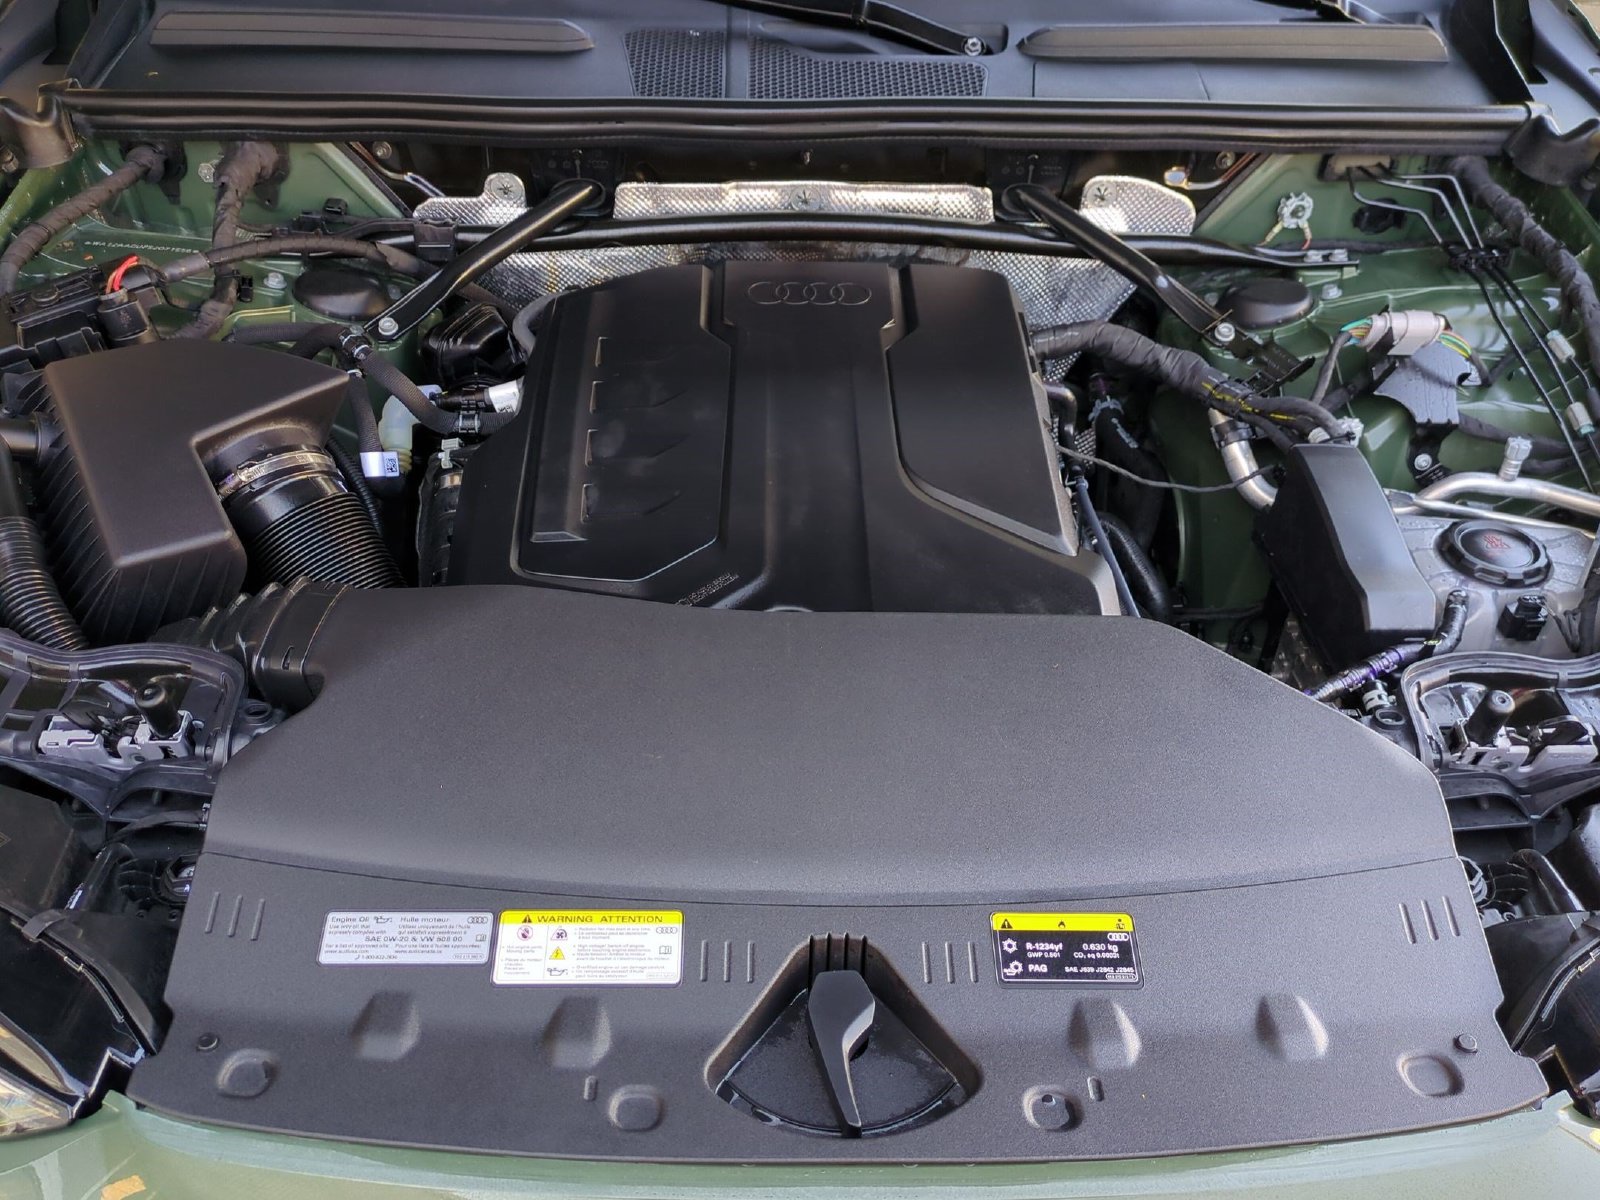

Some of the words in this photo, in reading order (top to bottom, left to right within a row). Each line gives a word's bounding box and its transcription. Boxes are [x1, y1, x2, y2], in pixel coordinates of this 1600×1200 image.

[537, 915, 593, 923] WARNING
[600, 915, 663, 923] ATTENTION
[1026, 942, 1063, 952] R-1234yf
[1082, 943, 1106, 951] 0.630
[1107, 943, 1119, 952] kg
[1028, 964, 1048, 972] PAG
